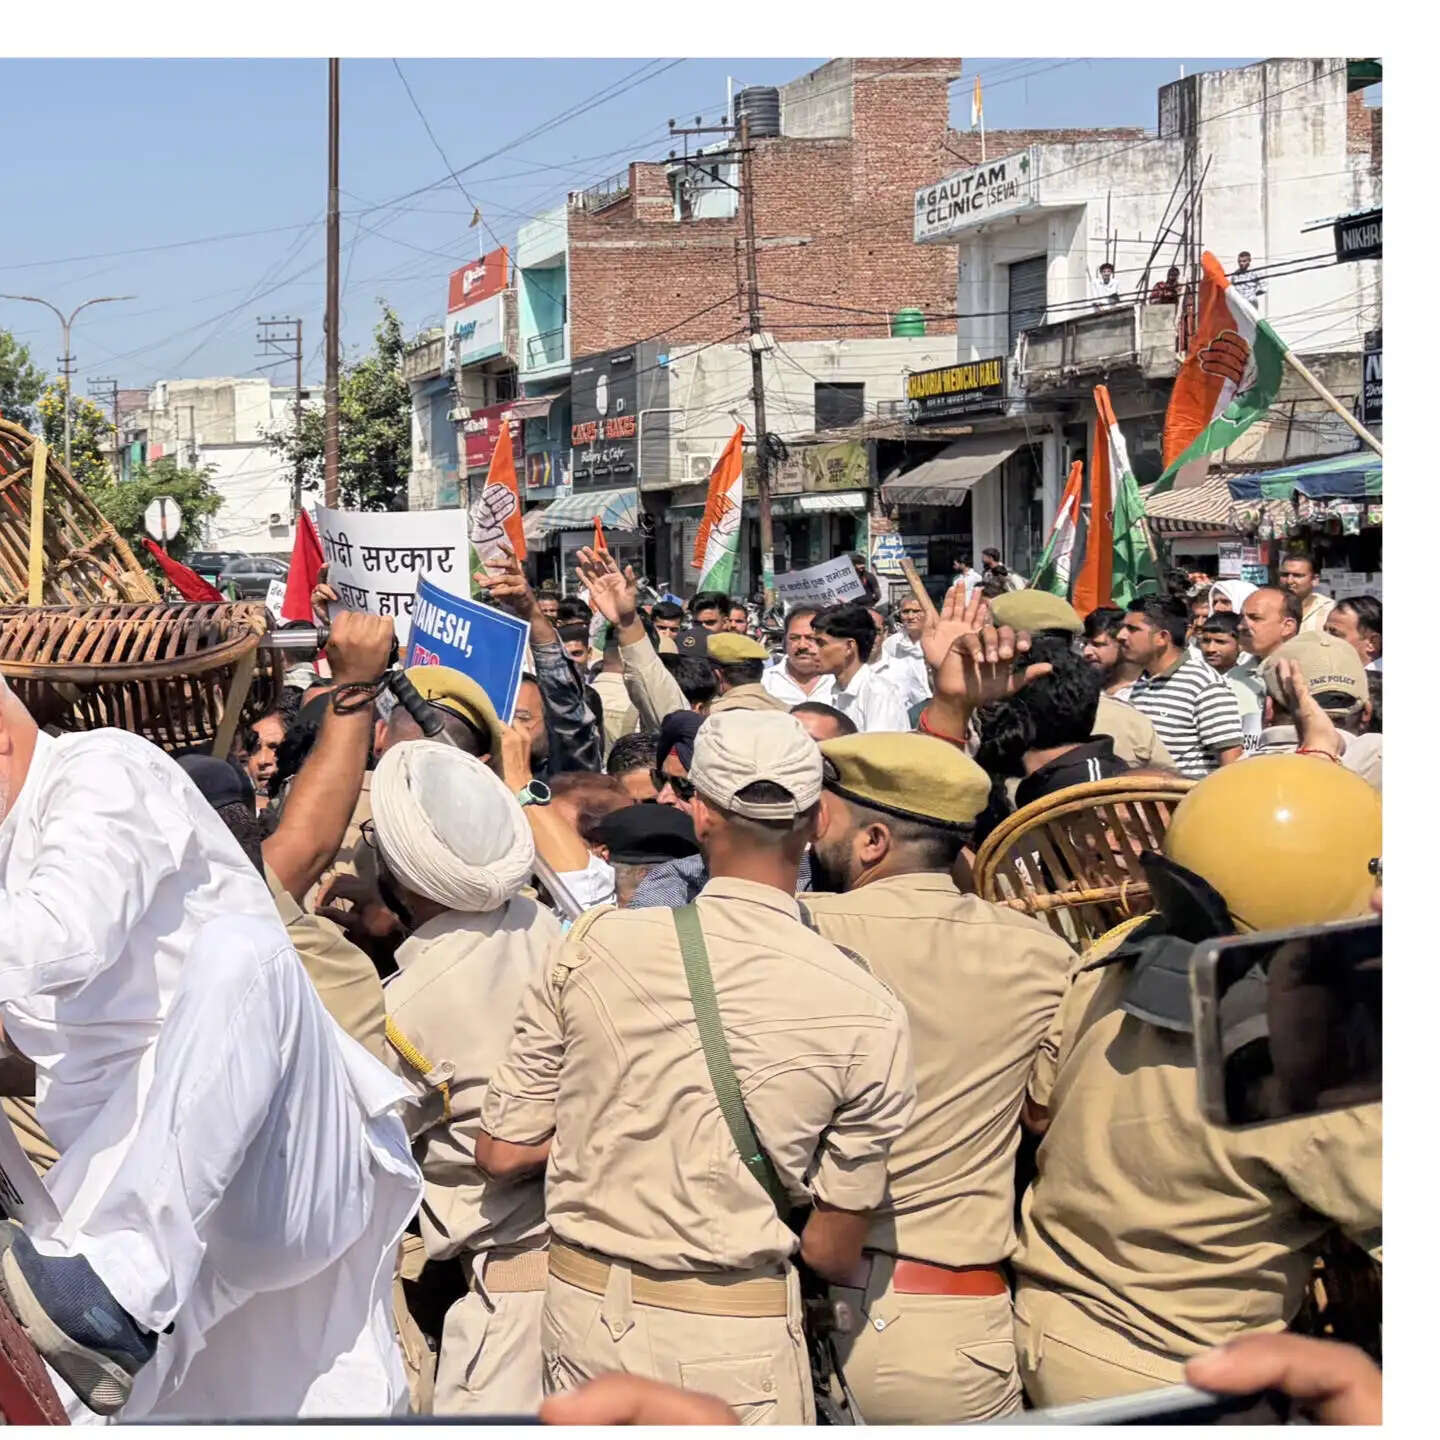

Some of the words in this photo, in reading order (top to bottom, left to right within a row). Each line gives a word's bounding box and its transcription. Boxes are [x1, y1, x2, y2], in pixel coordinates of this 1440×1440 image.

[927, 164, 1006, 206] GAUTAM
[926, 192, 984, 225] CLINIC
[943, 362, 979, 393] MEDICAL
[360, 546, 455, 574] सरकार
